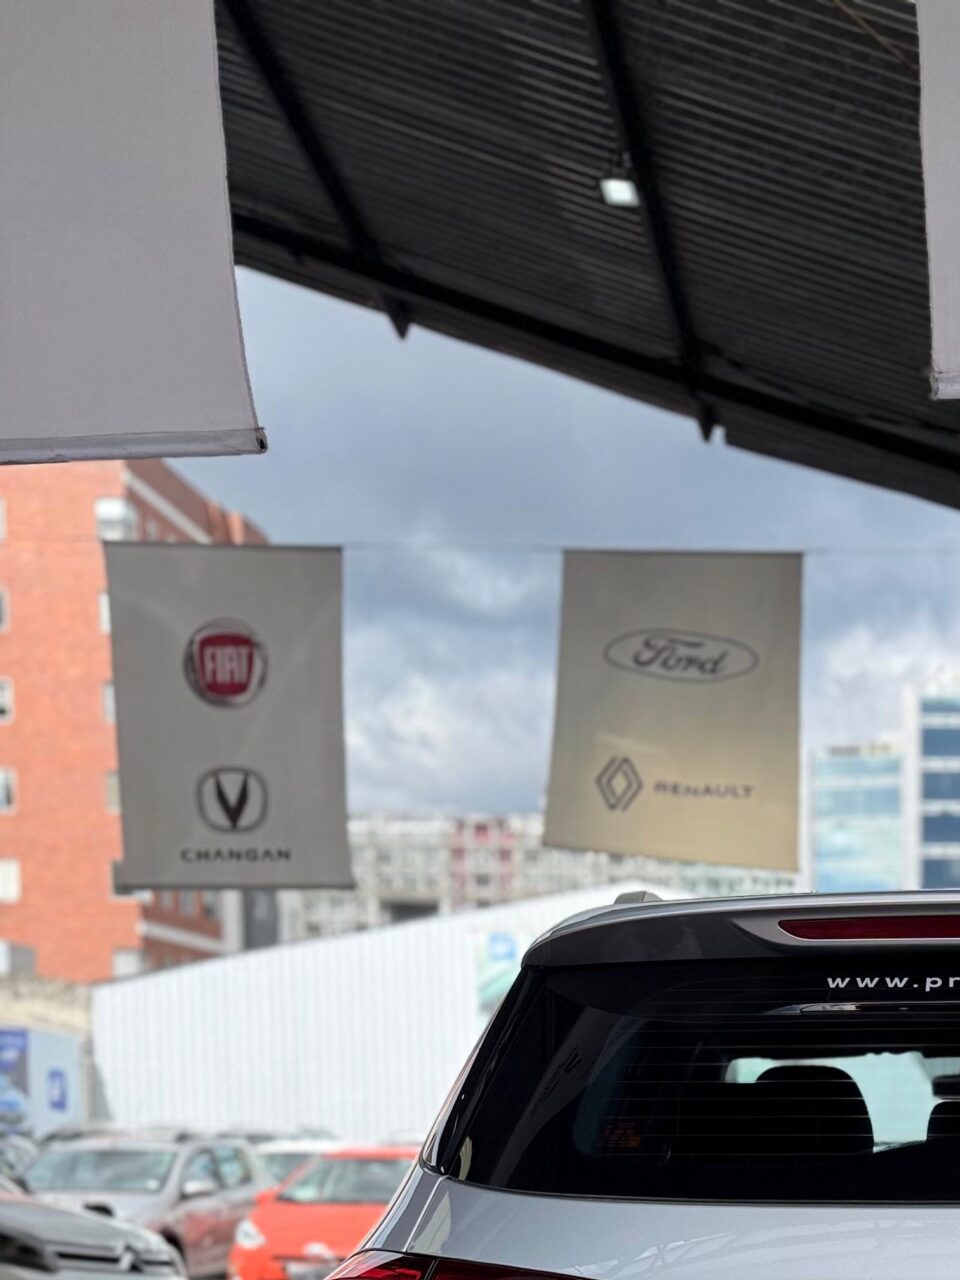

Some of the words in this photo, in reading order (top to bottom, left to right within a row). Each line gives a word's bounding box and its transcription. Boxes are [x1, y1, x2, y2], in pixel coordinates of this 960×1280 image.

[203, 645, 249, 684] FIAT
[632, 635, 729, 674] Ford
[653, 780, 755, 799] RENAULT
[180, 848, 291, 862] CHANGAN
